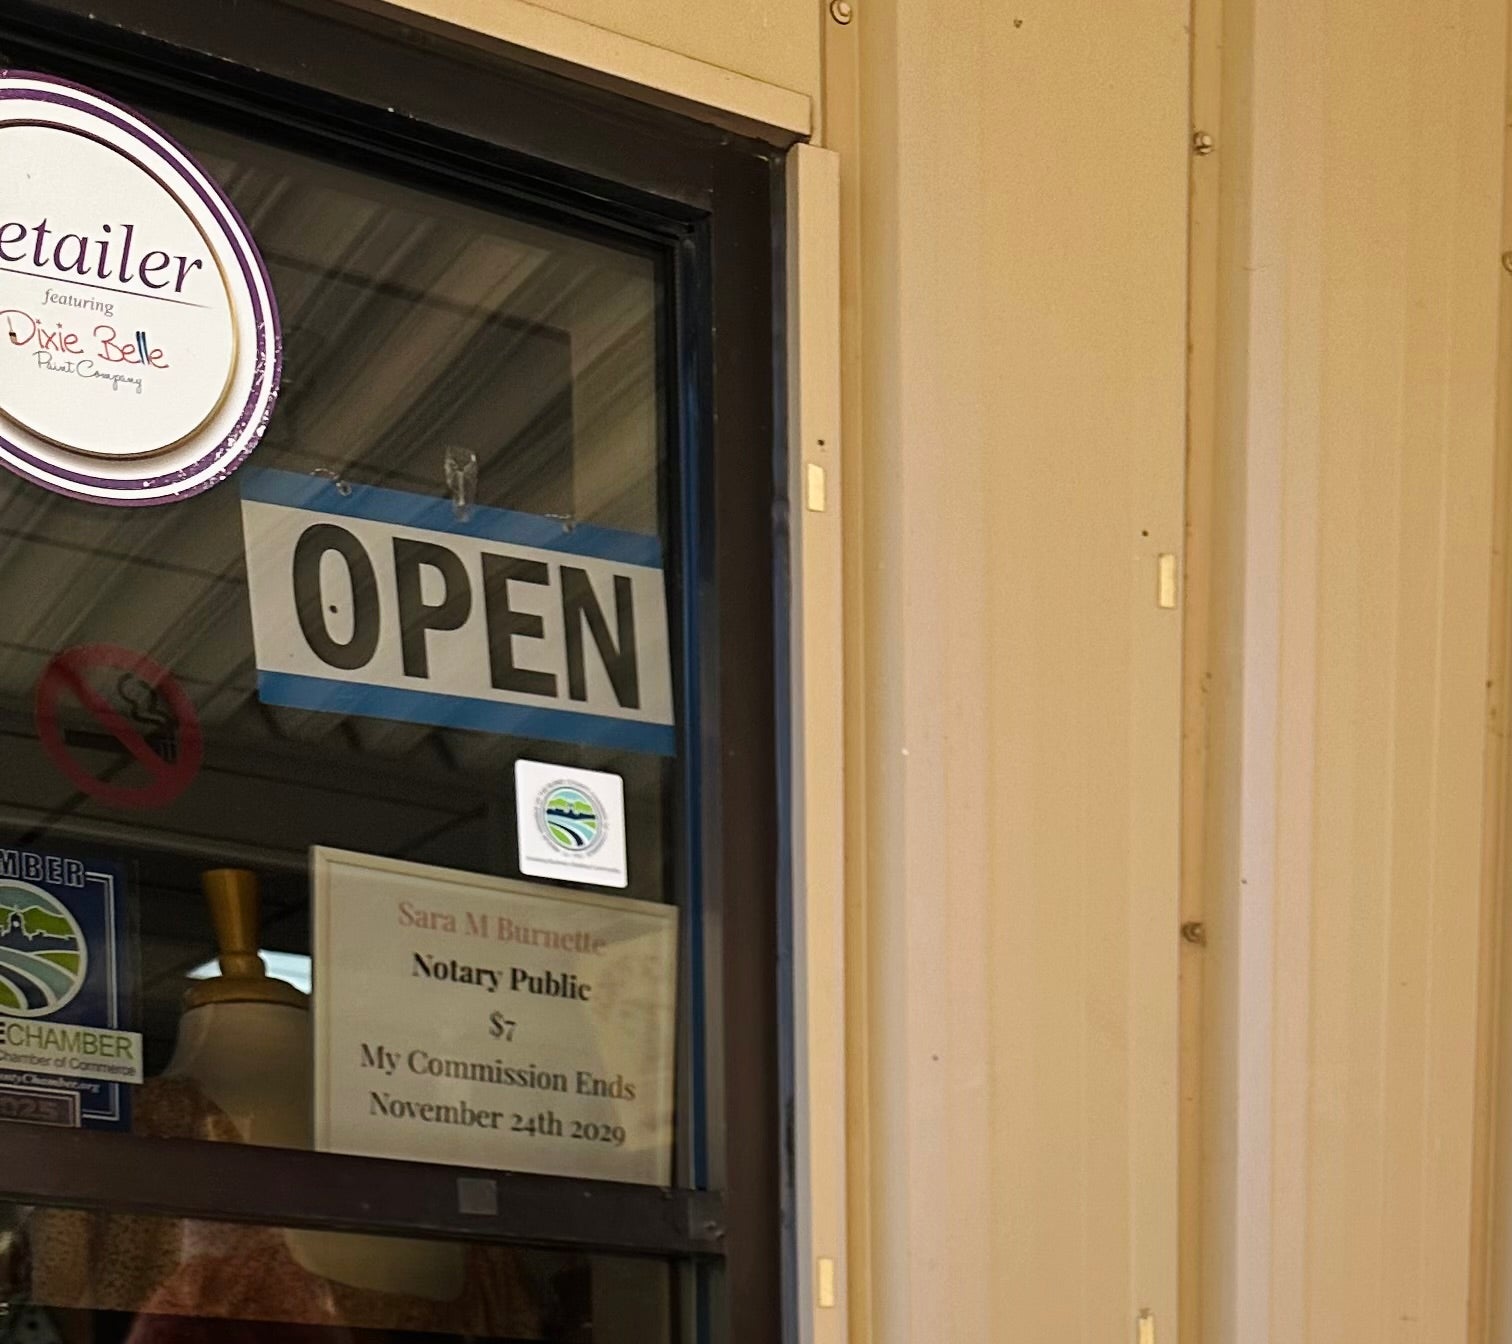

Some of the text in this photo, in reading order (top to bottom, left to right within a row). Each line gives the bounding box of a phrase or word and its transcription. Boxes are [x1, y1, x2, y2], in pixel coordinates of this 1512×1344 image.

[41, 288, 115, 317] featuring
[0, 309, 170, 369] Dixie Belle
[33, 350, 143, 394] Paint Company
[292, 523, 642, 710] OPEN
[398, 901, 607, 956] Sara M Burnette
[412, 952, 592, 1001] Notary Public
[489, 1010, 518, 1042] $7
[360, 1043, 637, 1101] My Commission Ends
[369, 1090, 626, 1147] November 24th 2029
